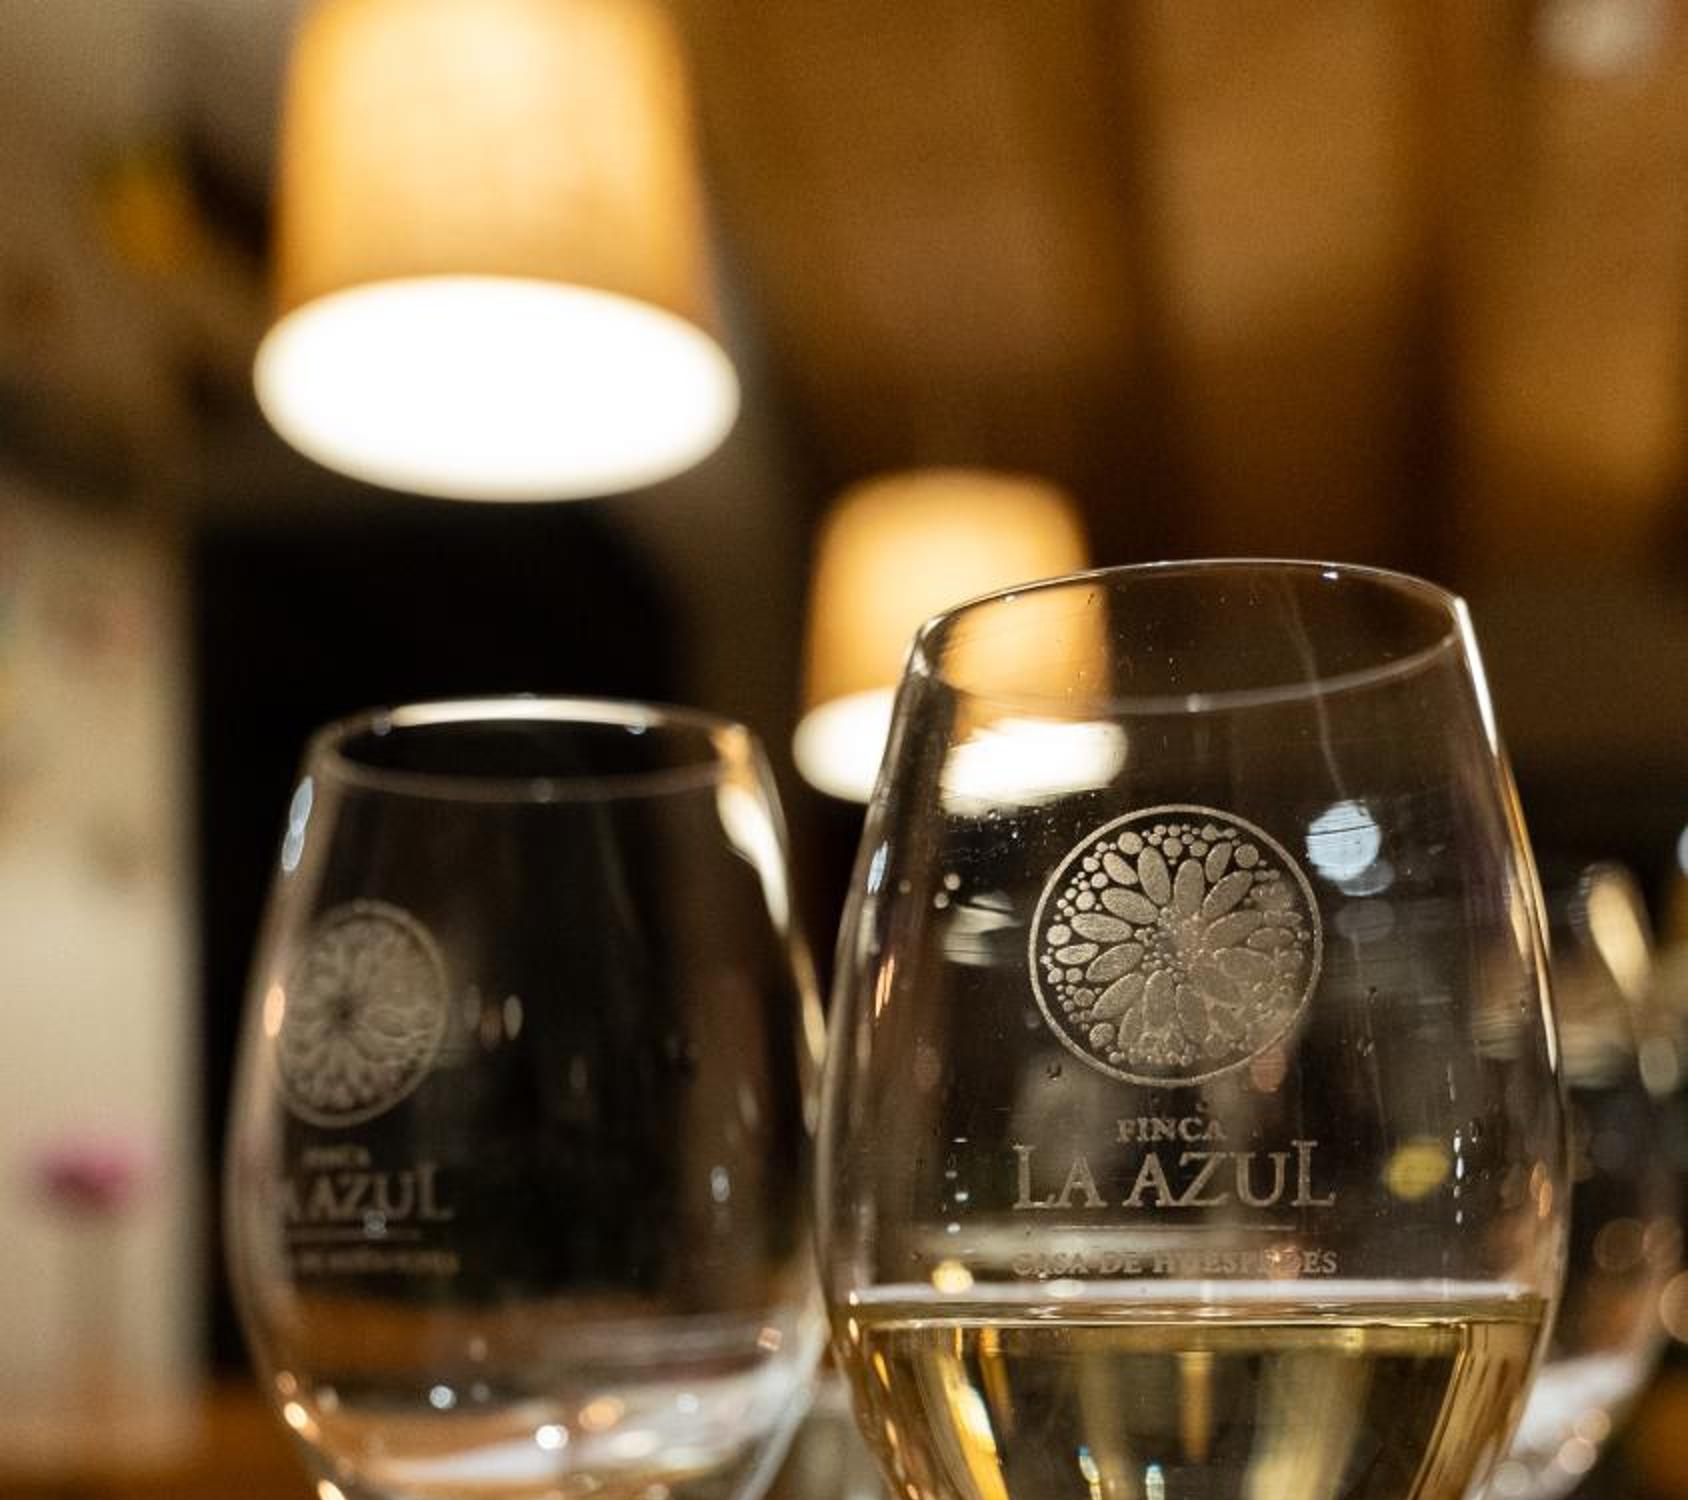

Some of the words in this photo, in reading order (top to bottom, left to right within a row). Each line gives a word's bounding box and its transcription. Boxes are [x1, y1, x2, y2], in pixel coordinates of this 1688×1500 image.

[1115, 1116, 1227, 1142] FINCA
[306, 1162, 454, 1221] AZUL
[1012, 1144, 1107, 1209] LA
[1122, 1139, 1336, 1207] AZUL
[1100, 1251, 1143, 1274] DE
[1151, 1248, 1338, 1275] HUESPES
